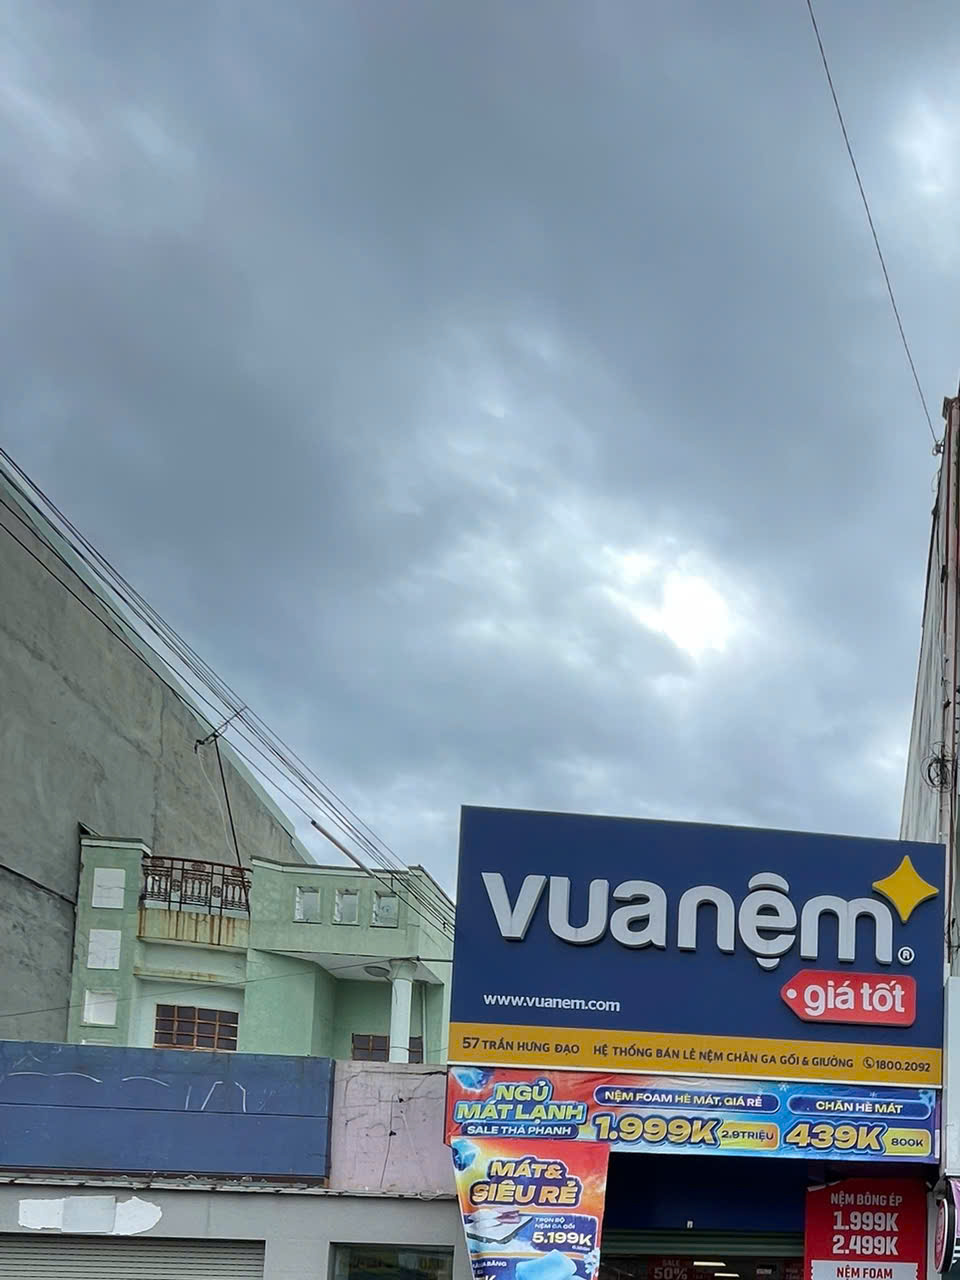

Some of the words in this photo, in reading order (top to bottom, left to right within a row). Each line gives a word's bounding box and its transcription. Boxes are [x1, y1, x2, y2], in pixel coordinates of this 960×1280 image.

[480, 871, 894, 971] vuanệm
[483, 992, 621, 1013] www.vuanem.com
[803, 979, 852, 1018] giá
[859, 980, 906, 1013] tốt
[462, 1037, 480, 1049] 57
[481, 1037, 514, 1051] TRẦN
[517, 1040, 550, 1053] HƯNG
[554, 1043, 580, 1056] ĐẠO
[593, 1043, 608, 1057] HỆ
[612, 1043, 653, 1058] THỐNG
[655, 1046, 680, 1060] BÁN
[698, 1050, 723, 1063] NỆM
[761, 1054, 777, 1064] GA
[780, 1053, 800, 1065] GỐI
[812, 1055, 853, 1068] GIƯỜNG
[875, 1059, 931, 1073] 1800.2092
[494, 1080, 549, 1101] NGỦ
[605, 1090, 634, 1102] NỆM
[636, 1092, 672, 1104] FOAM
[693, 1092, 722, 1106] MÁT,
[724, 1094, 745, 1107] GIÁ
[747, 1094, 762, 1107] RẺ
[456, 1100, 513, 1120] MÁT
[515, 1103, 584, 1124] LẠNH
[816, 1099, 854, 1111] CHĂN
[855, 1101, 873, 1112] HÈ
[875, 1101, 903, 1114] MÁT
[467, 1125, 498, 1134] SALE
[501, 1124, 527, 1135] THẢ
[528, 1126, 572, 1136] PHANH
[595, 1115, 717, 1144] 1.999K
[786, 1123, 881, 1150] 439K
[891, 1138, 924, 1147] 800K
[471, 1180, 535, 1203] SIÊU
[539, 1180, 578, 1203] RẺ
[830, 1191, 855, 1208] NỆM
[856, 1192, 887, 1206] BÔNG
[889, 1192, 903, 1207] ÉP
[833, 1211, 899, 1232] 1.999K
[532, 1231, 593, 1246] 5.199K
[832, 1234, 899, 1256] 2.499K
[654, 1267, 688, 1280] 50%
[836, 1265, 860, 1280] NỆM
[862, 1267, 893, 1279] FOAM
